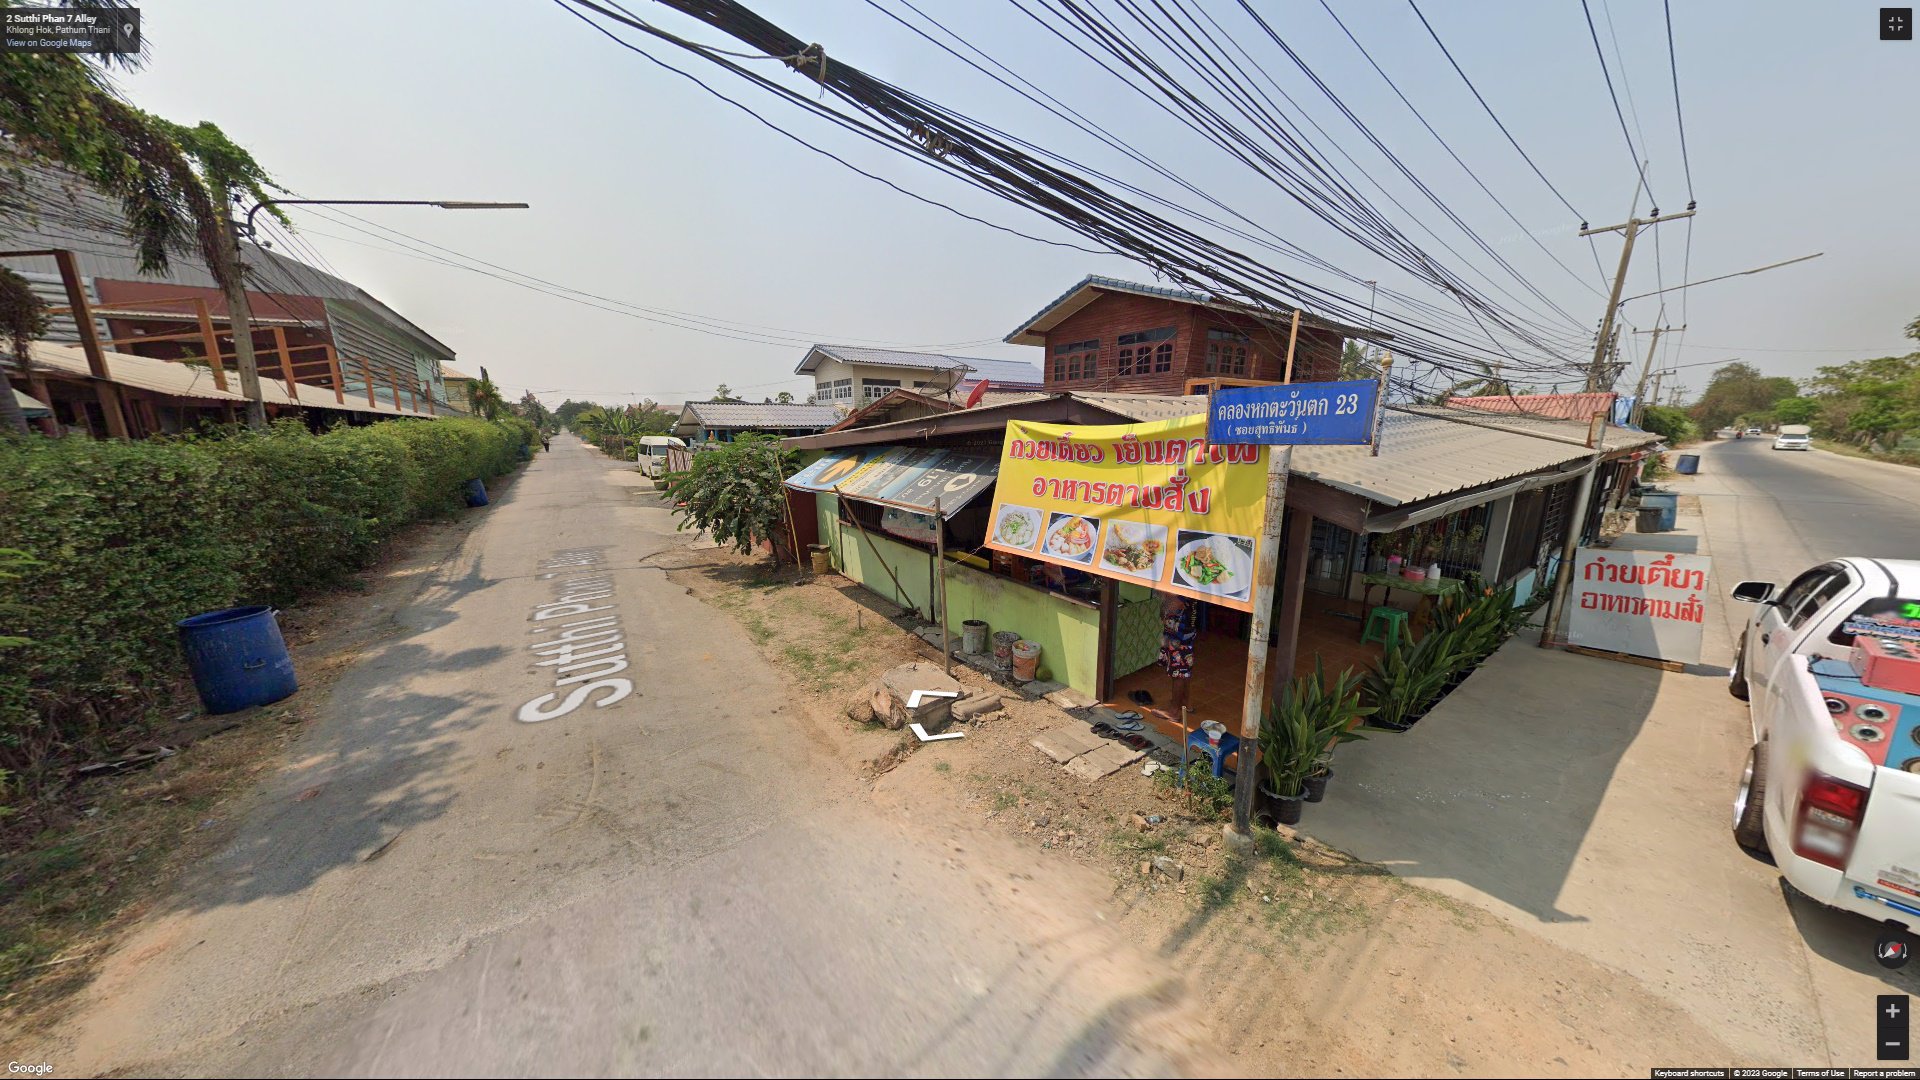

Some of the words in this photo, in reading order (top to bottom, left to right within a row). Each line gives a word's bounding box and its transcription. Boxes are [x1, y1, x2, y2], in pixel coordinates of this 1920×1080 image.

[1218, 391, 1329, 421] คลองหกตะวันตก
[1335, 393, 1359, 415] 23
[1032, 468, 1211, 515] อาหารตามสั่ง
[1584, 554, 1705, 591] ก๋วยเตี๋ยว
